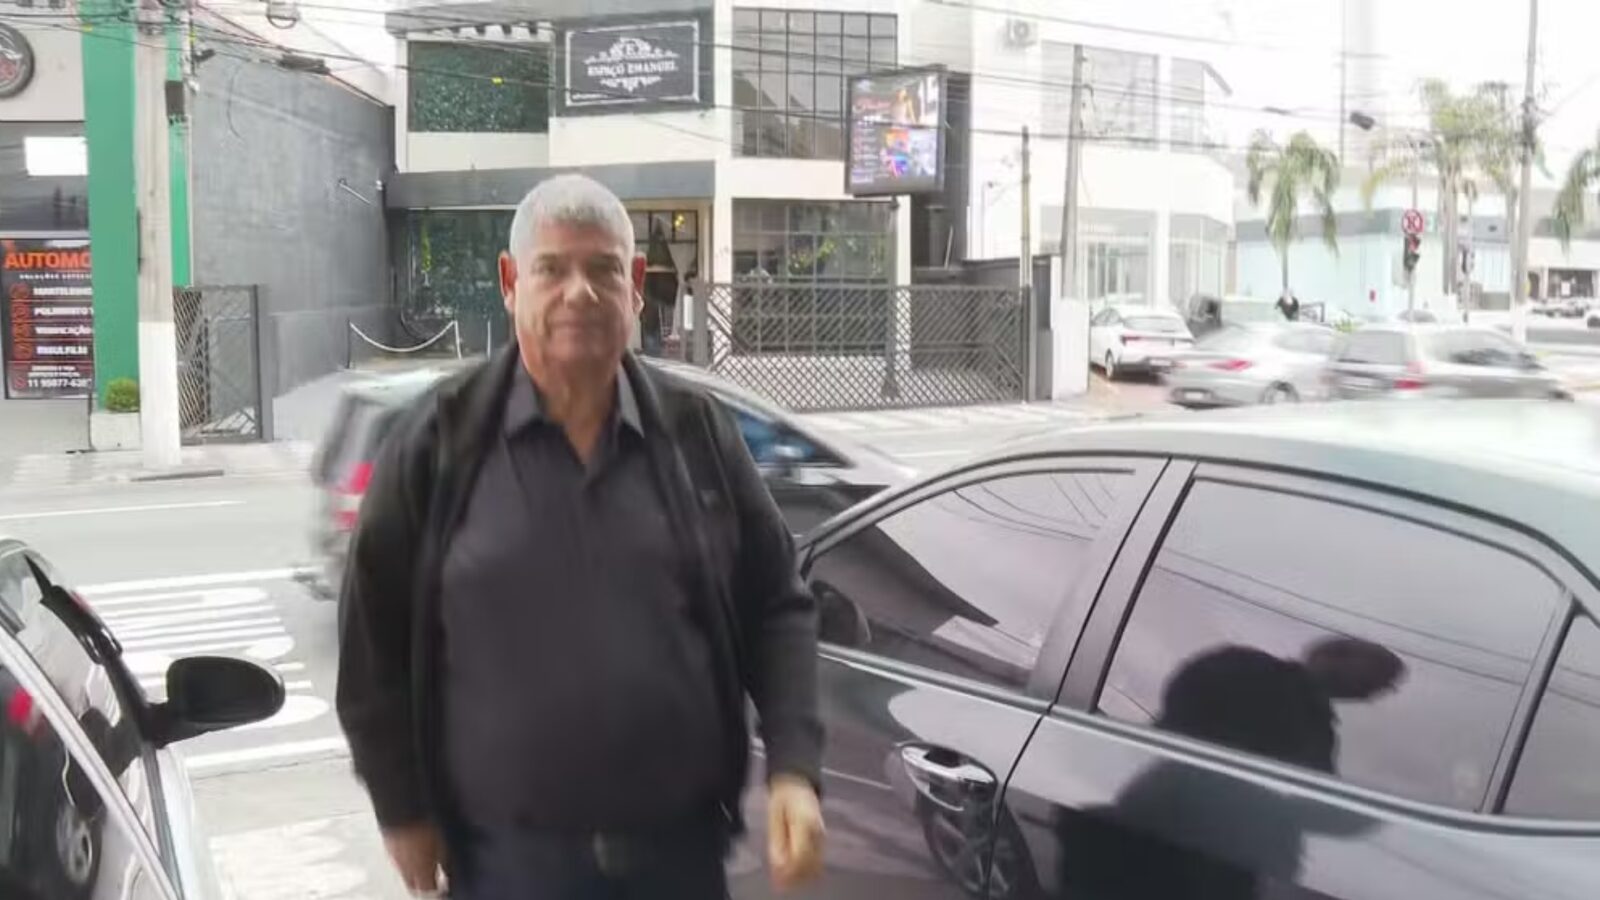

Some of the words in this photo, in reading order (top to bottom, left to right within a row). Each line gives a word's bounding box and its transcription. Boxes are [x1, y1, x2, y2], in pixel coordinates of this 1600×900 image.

[588, 65, 624, 77] ESPAÇO
[628, 60, 678, 74] EMANUEL
[28, 379, 39, 388] 11
